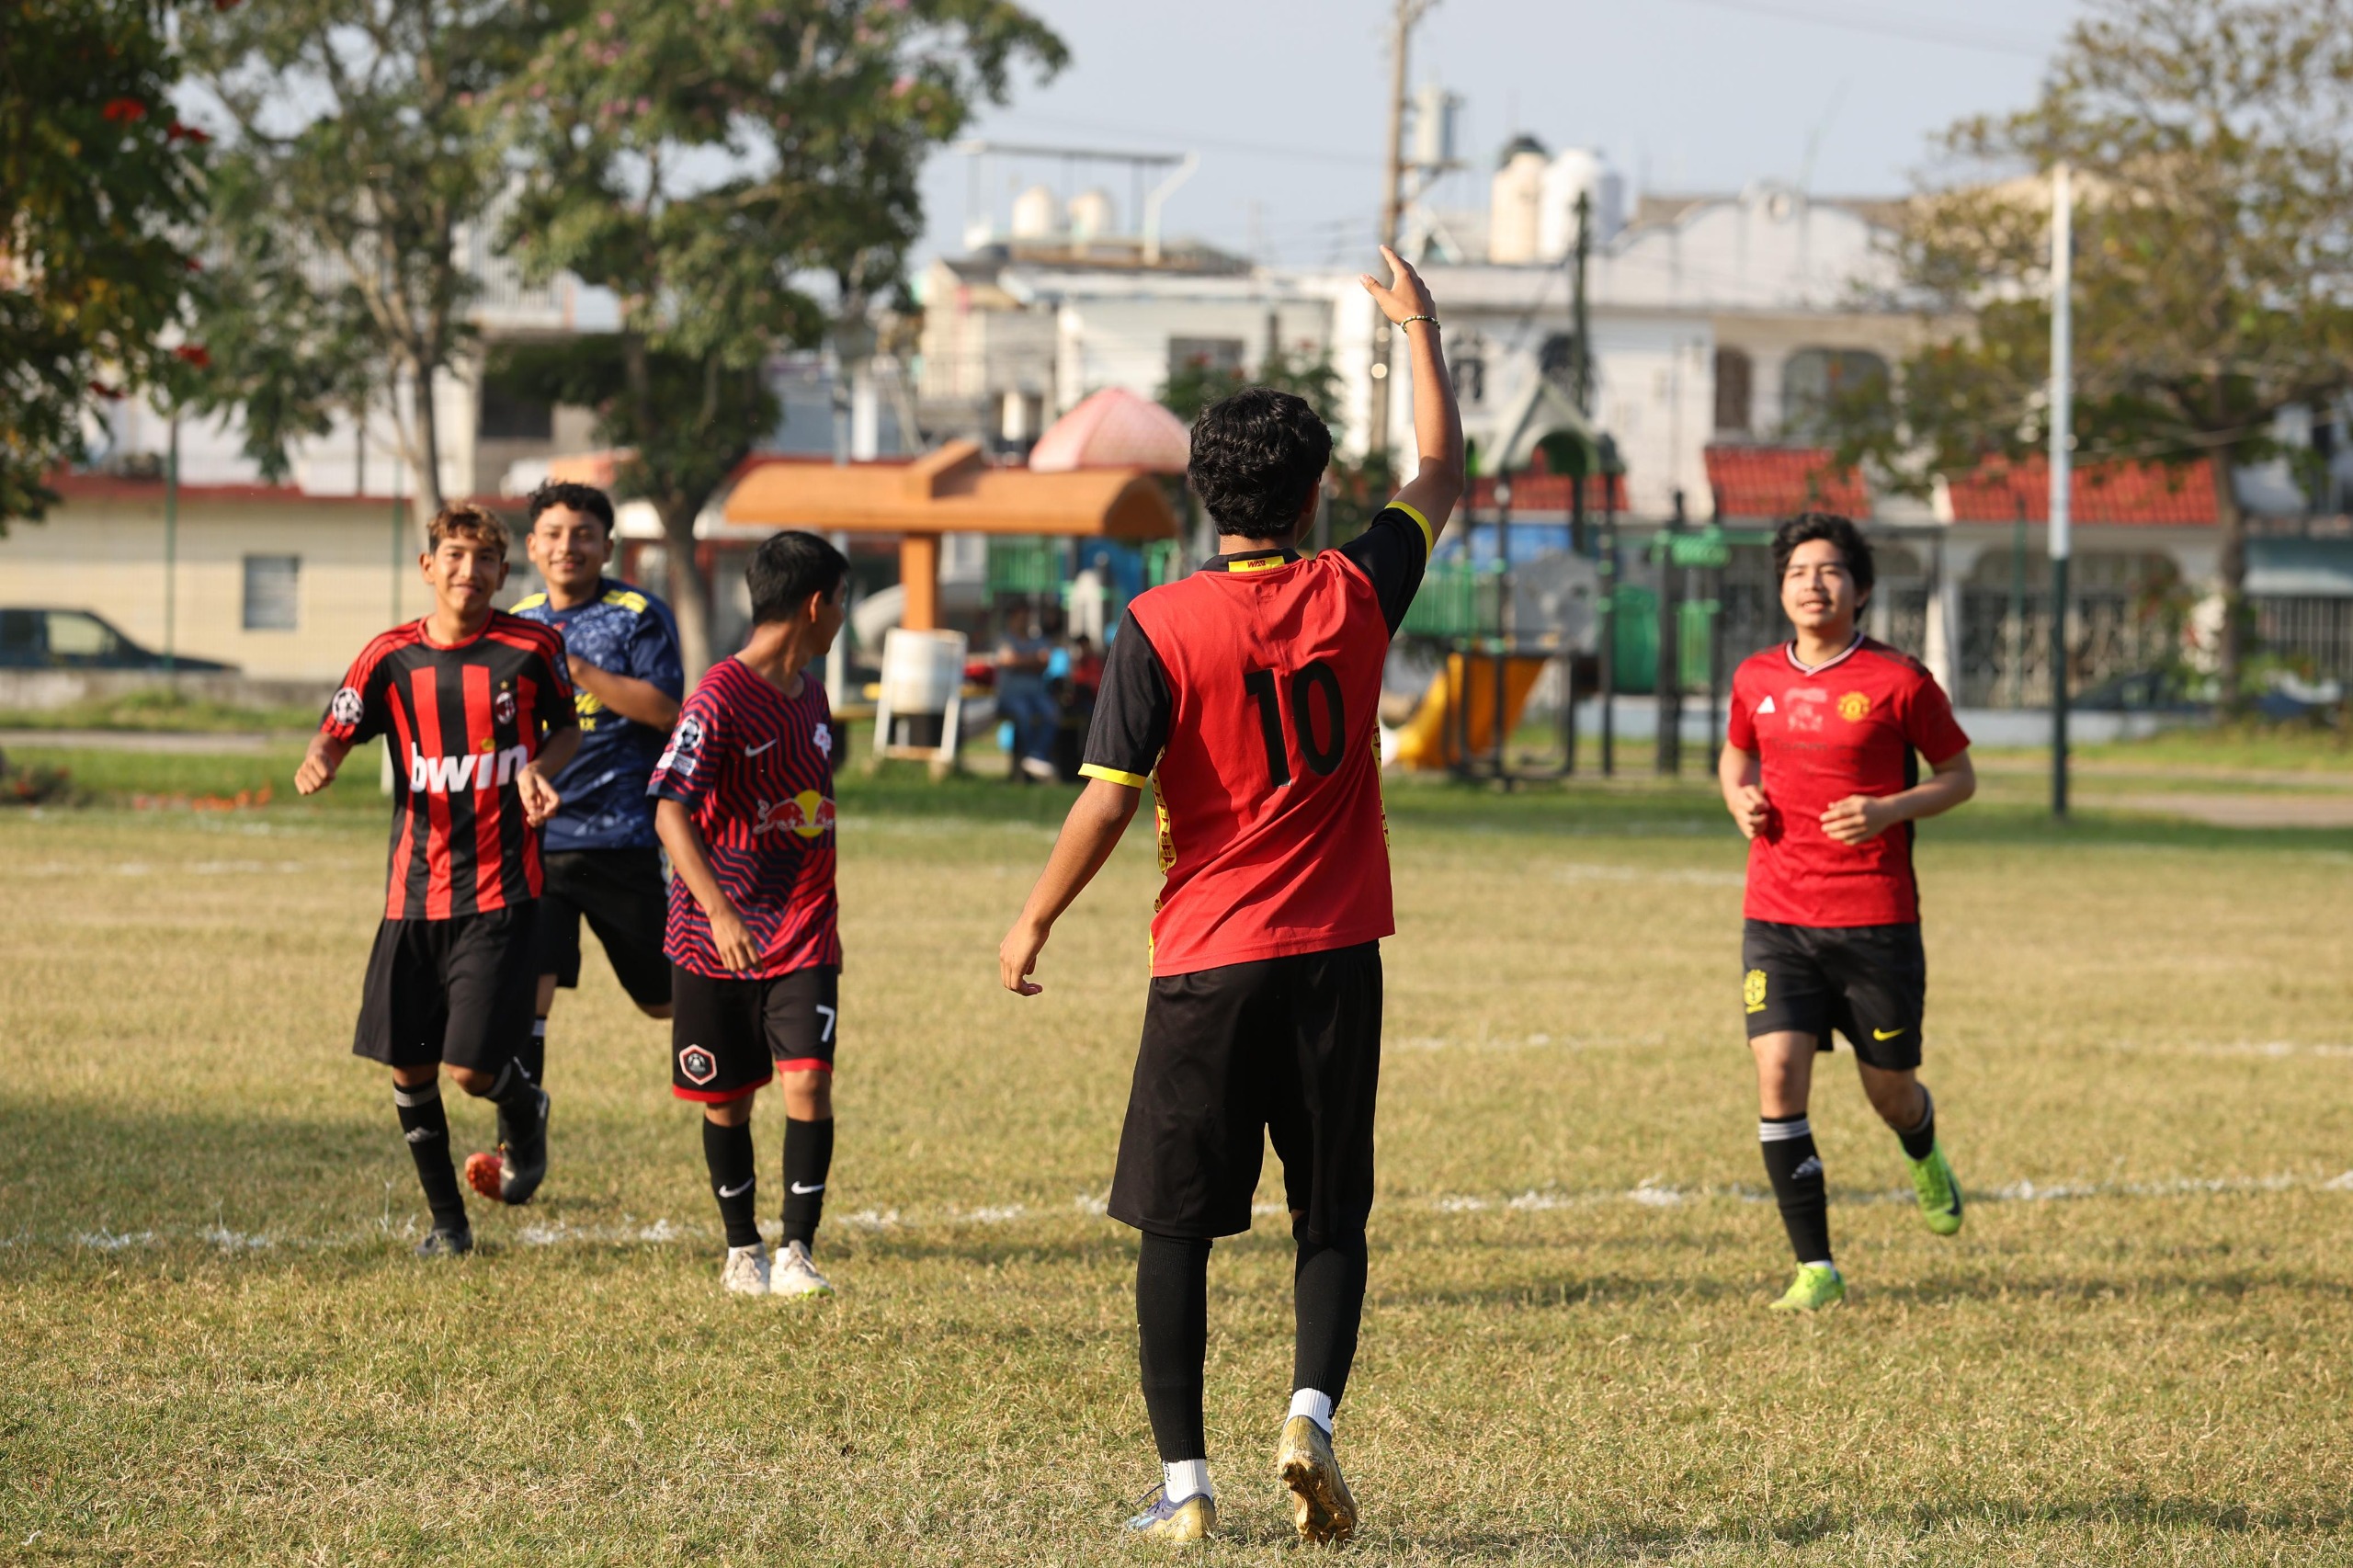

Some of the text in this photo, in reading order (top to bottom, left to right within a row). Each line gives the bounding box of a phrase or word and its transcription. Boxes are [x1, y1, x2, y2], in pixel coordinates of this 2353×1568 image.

[1244, 660, 1346, 789] 10
[410, 738, 528, 794] bwin
[816, 1004, 835, 1042] 7
